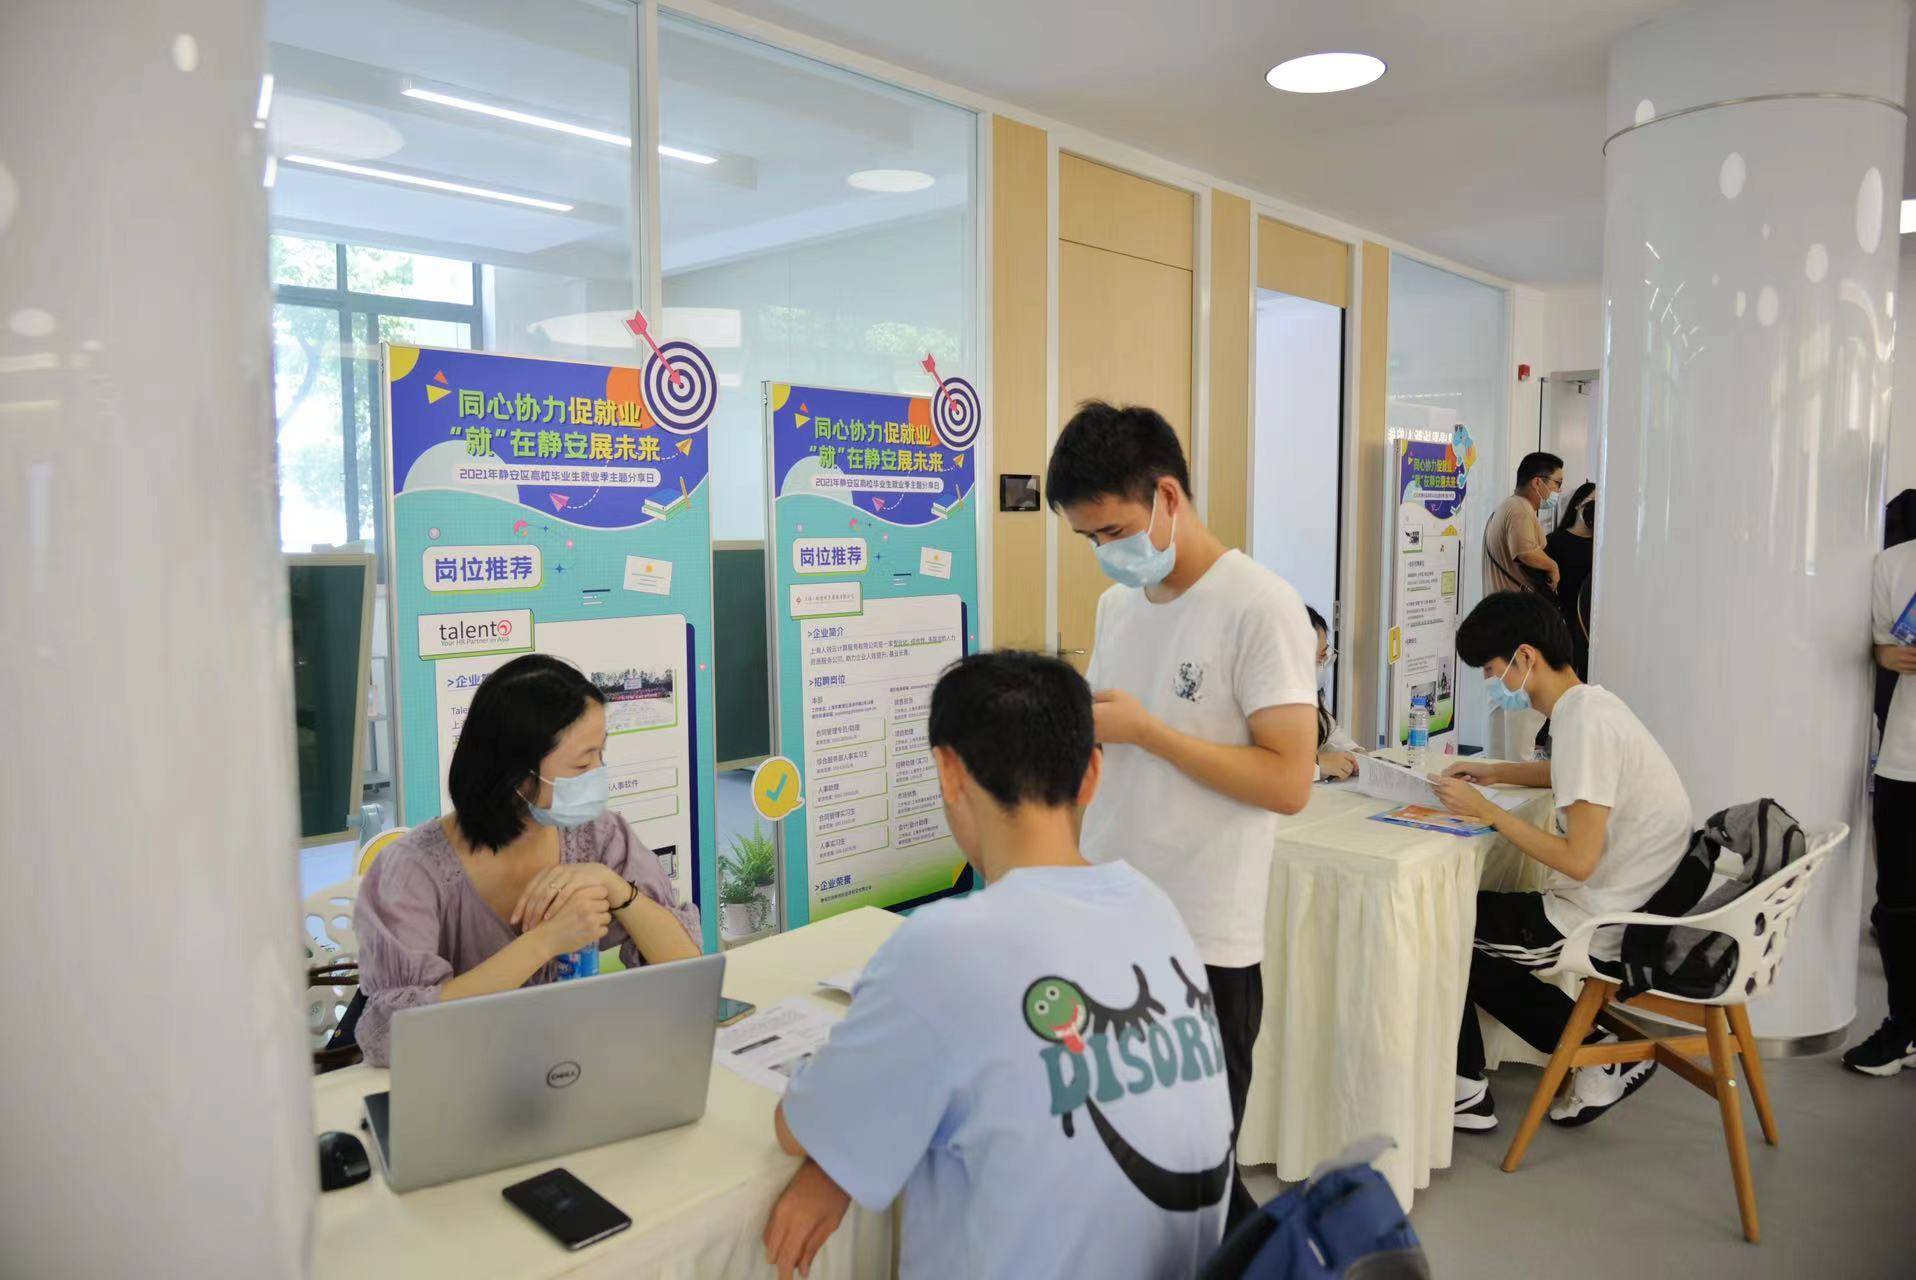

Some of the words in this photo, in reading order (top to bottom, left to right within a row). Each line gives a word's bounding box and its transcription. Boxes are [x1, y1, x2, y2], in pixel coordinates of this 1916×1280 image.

[458, 389, 642, 427] 同心协力促就业
[814, 416, 932, 445] 同心协力促就业
[459, 467, 655, 484] 2021年静安区高校毕业生就业季主题分享日
[800, 546, 862, 567] 岗位推荐
[434, 556, 533, 583] 岗位推荐
[812, 626, 844, 639] 企业简介
[814, 674, 846, 687] 招聘岗位
[820, 875, 852, 892] 企业荣誉
